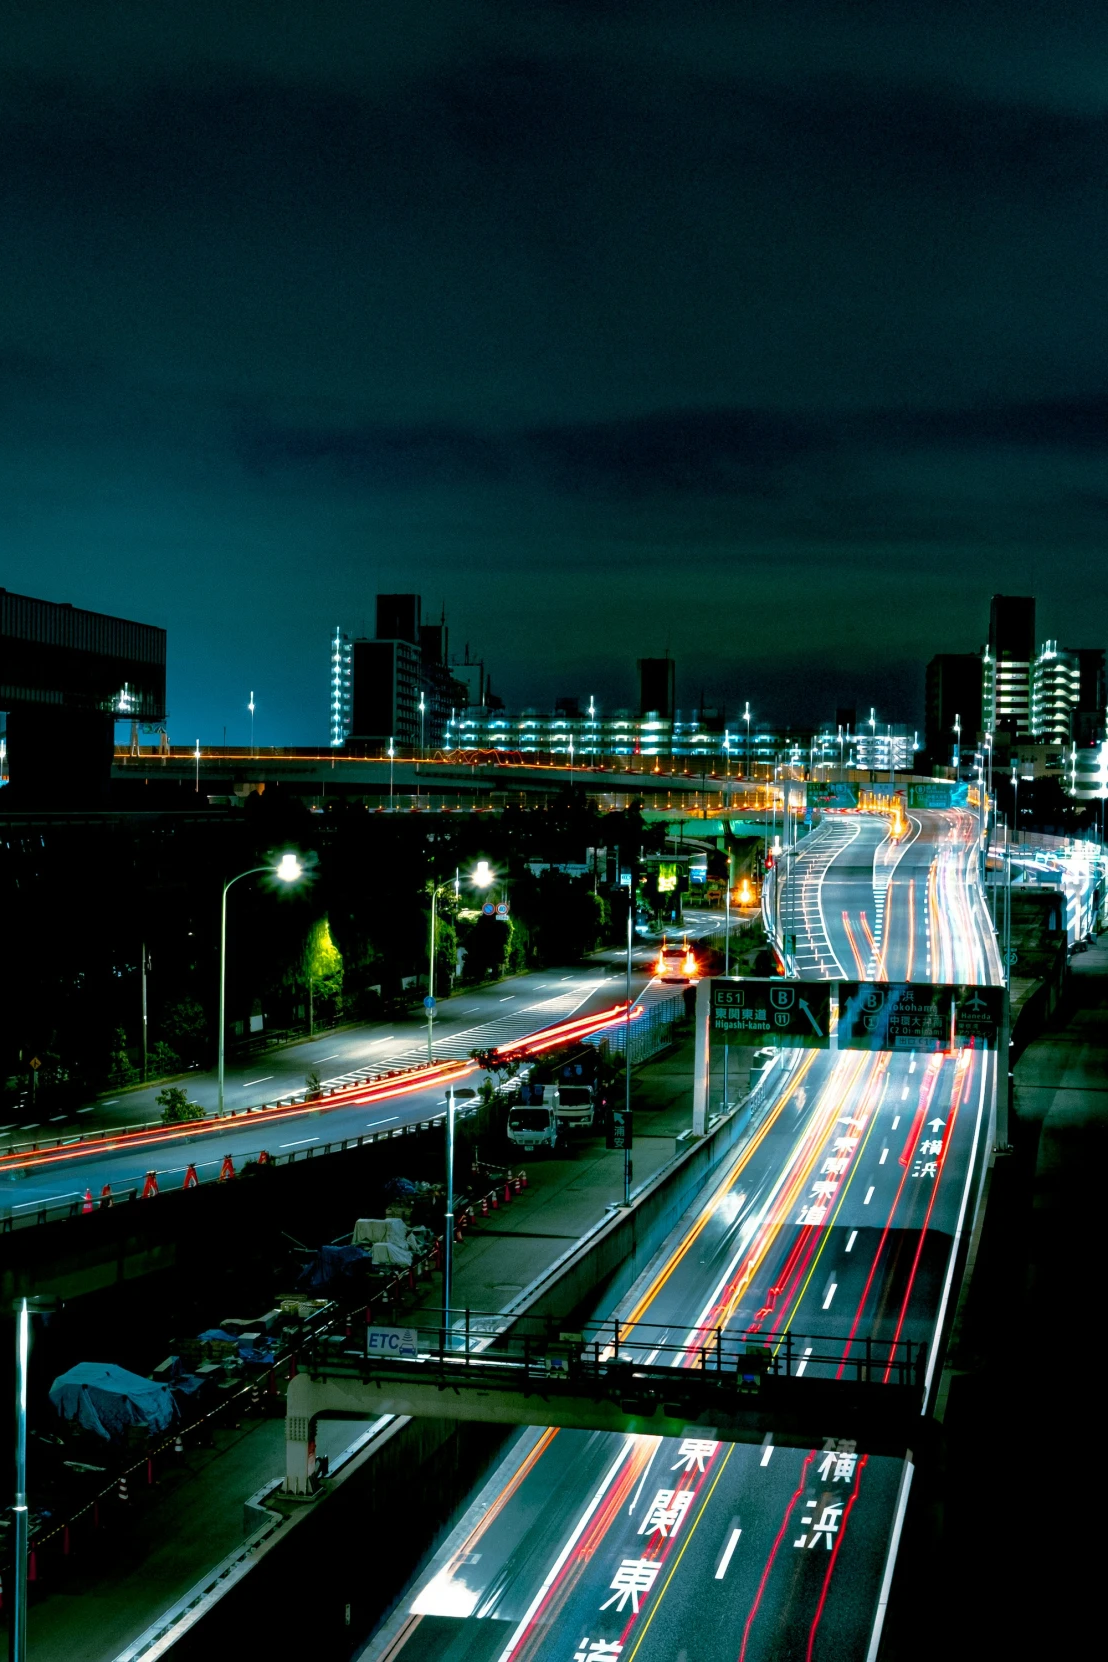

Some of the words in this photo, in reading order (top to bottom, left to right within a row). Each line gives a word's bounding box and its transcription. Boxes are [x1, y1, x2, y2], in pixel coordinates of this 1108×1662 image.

[717, 992, 741, 1003] E51
[778, 991, 788, 1005] B
[867, 994, 877, 1008] B
[715, 1007, 767, 1021] 東関東道
[777, 1015, 786, 1024] 11
[961, 1011, 992, 1020] Haneda
[715, 1020, 771, 1031] Higashi-kanto
[868, 1018, 875, 1027] 1
[912, 1139, 943, 1178] 横浜
[795, 1136, 858, 1226] 東関東道
[368, 1332, 400, 1351] ETC
[793, 1437, 858, 1551] 横浜
